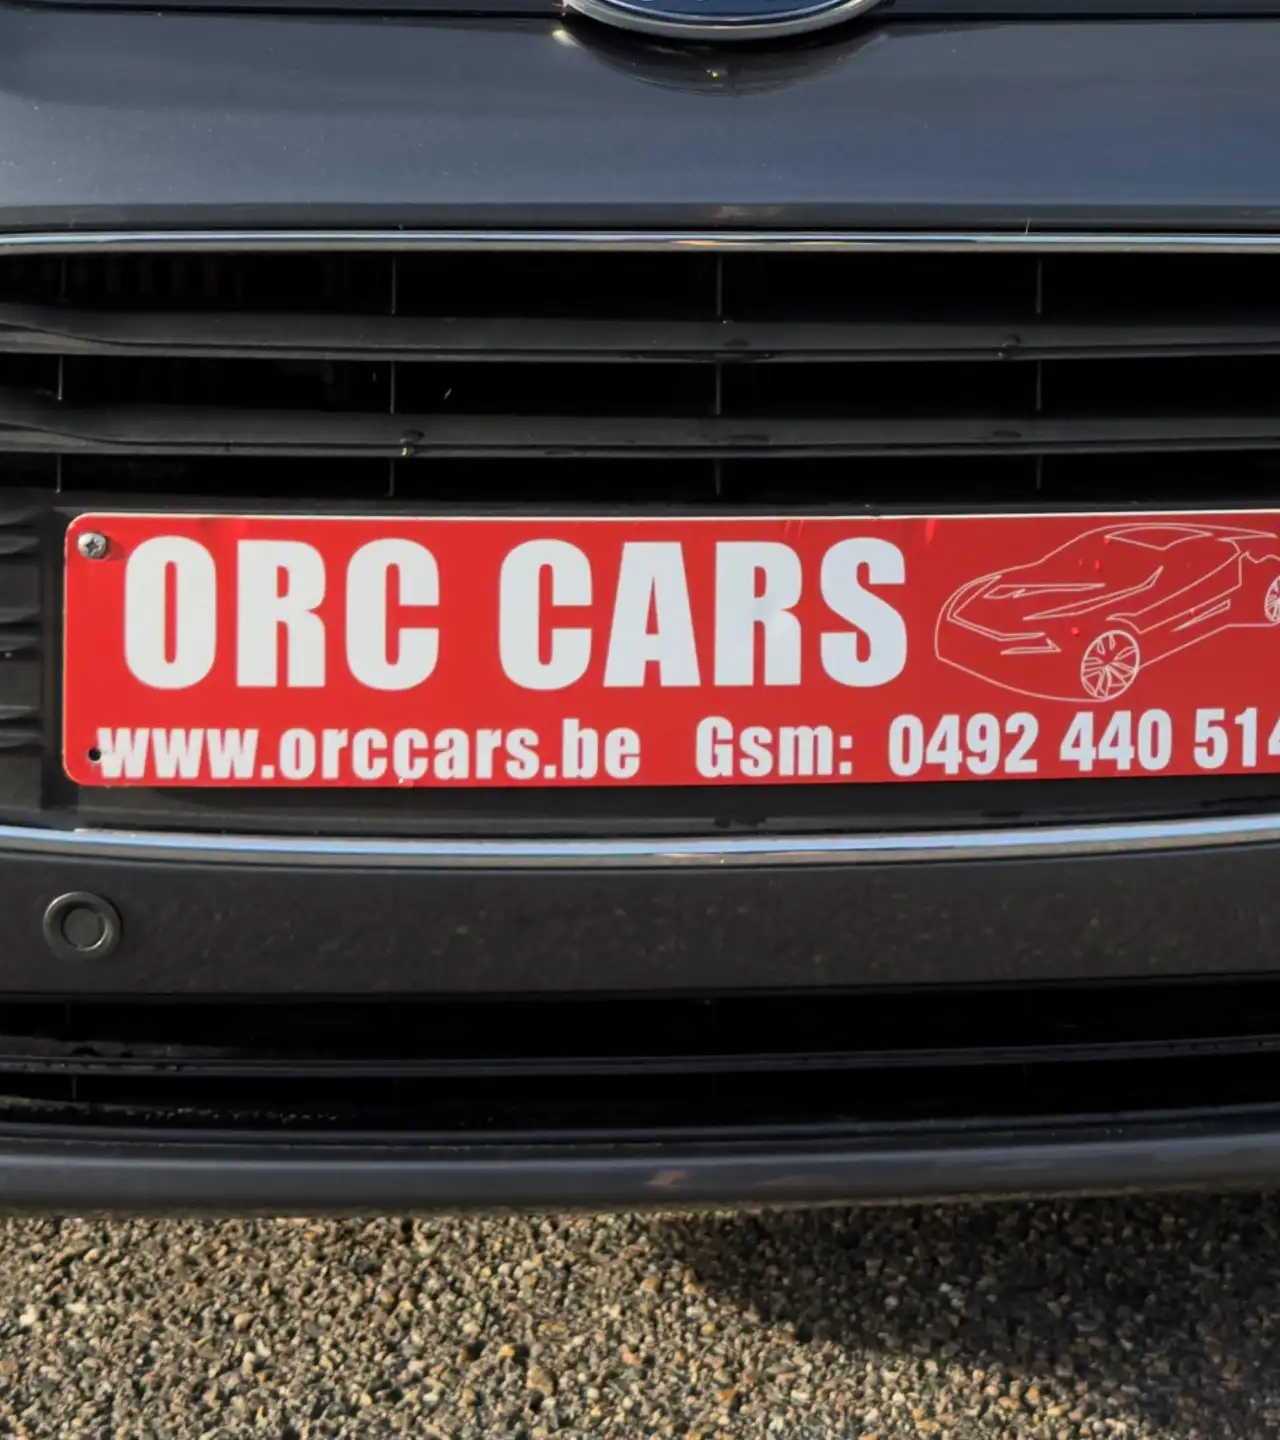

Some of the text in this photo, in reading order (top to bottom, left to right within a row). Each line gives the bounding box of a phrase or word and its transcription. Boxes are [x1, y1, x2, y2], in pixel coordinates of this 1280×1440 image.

[124, 535, 908, 691] ORC CARS
[95, 716, 641, 780] www.orccars.be
[695, 715, 853, 778] Gsm:
[888, 712, 1040, 777] 0492
[1059, 708, 1172, 772] 440
